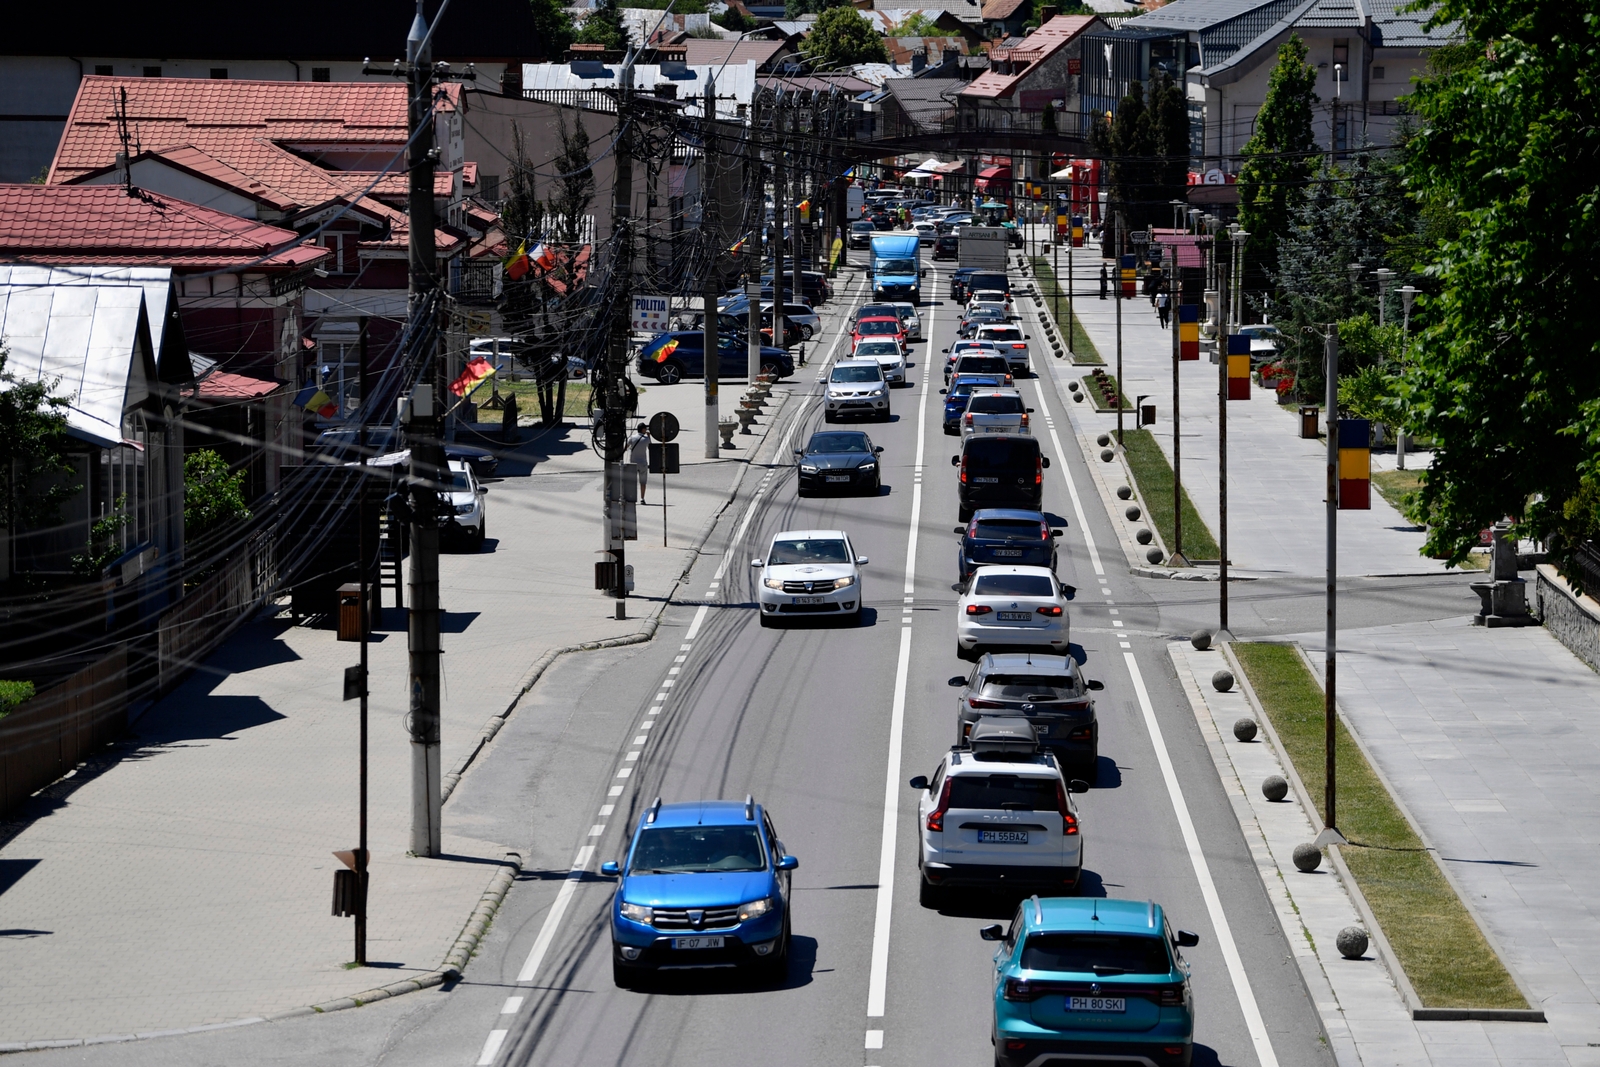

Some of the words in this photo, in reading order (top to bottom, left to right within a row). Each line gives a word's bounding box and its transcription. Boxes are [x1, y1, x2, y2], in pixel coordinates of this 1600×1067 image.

[983, 832, 996, 841] PH
[998, 832, 1026, 841] 55BAZ
[677, 939, 686, 948] IF
[689, 939, 700, 948] 07
[1072, 998, 1087, 1008] PH
[1091, 999, 1103, 1009] 80
[1105, 999, 1122, 1009] SKI
